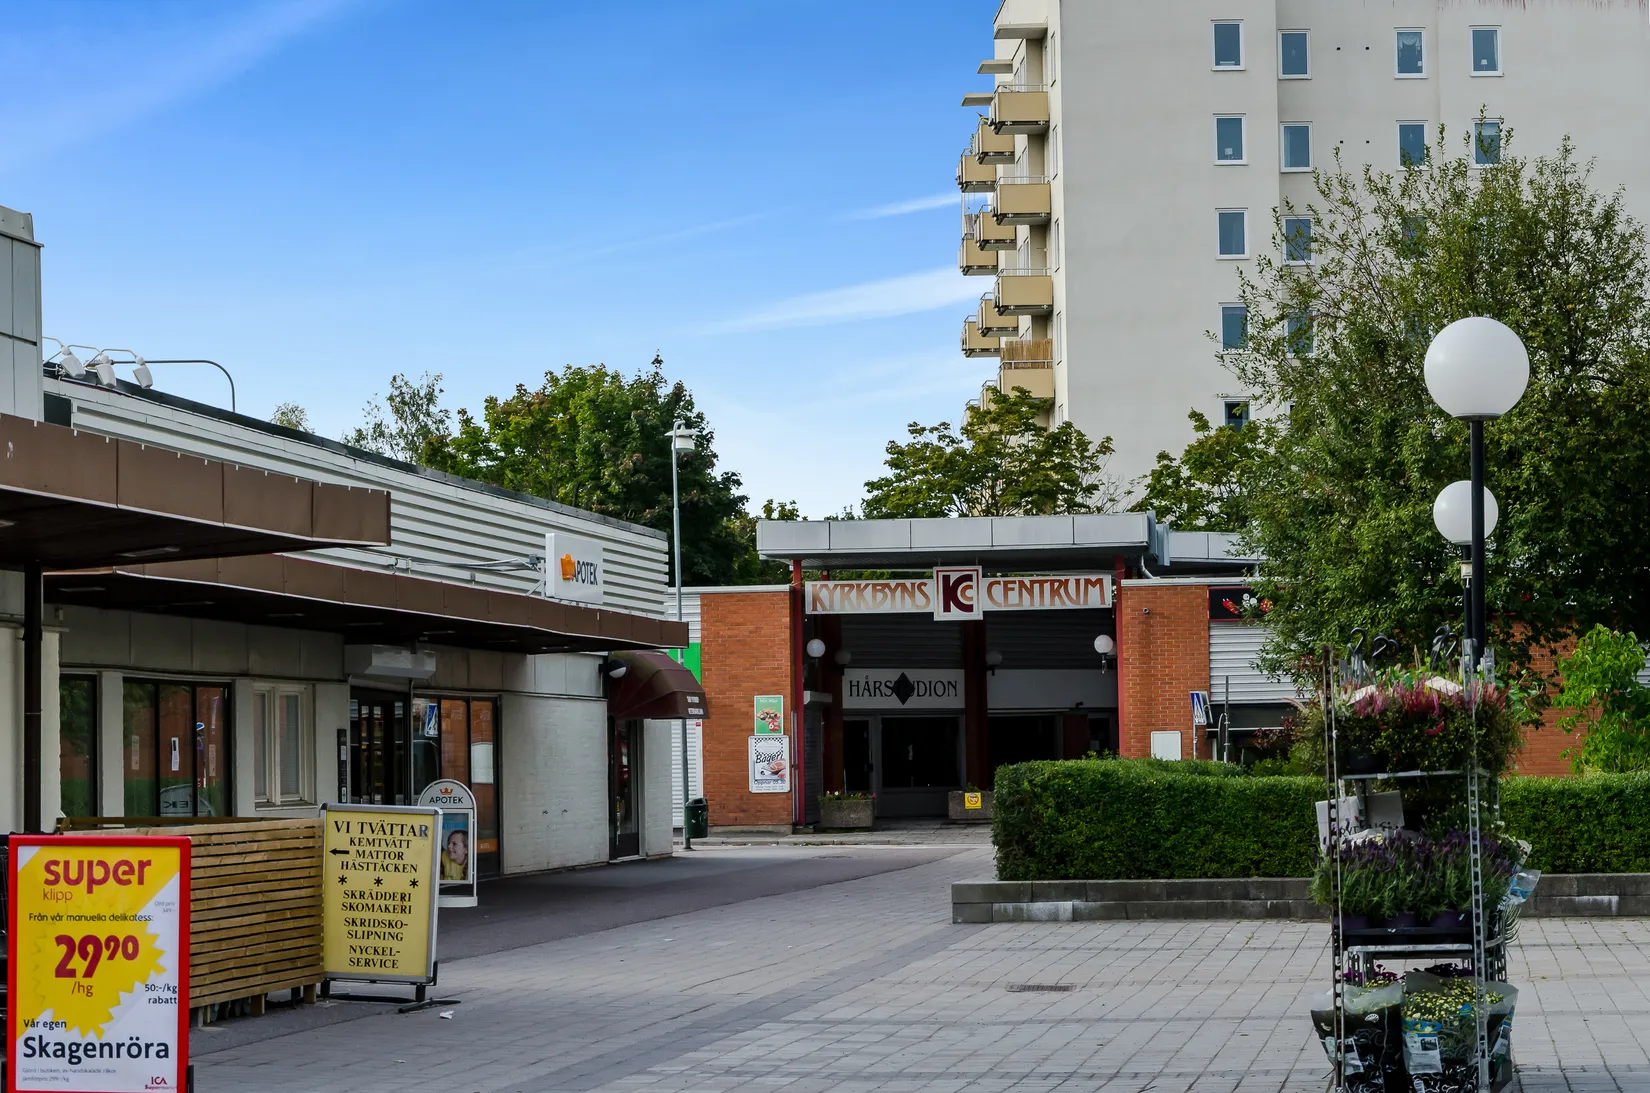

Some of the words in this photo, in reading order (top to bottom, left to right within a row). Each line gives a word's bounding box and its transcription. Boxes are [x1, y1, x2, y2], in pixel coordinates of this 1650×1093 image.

[810, 581, 931, 612] KYRKBYNS
[986, 578, 1106, 609] CENTRUM
[428, 796, 464, 804] APOTEK
[334, 820, 351, 834] VI
[357, 819, 429, 838] TVÄTTAR
[349, 836, 412, 849] KEMTVÄTT
[355, 849, 405, 861] MATTOR
[340, 860, 418, 873] HÄSTTÄCKEN
[43, 859, 152, 894] super
[43, 888, 73, 903] klipp
[343, 889, 412, 902] SKRÄDDERI
[341, 902, 412, 914] SKOMAKERI
[29, 912, 48, 922] Från
[50, 912, 63, 922] vår
[66, 912, 107, 922] manuella
[108, 912, 154, 922] delikatess:
[343, 917, 408, 929] SKRIDSKO-
[346, 930, 404, 941] SLIPNING
[349, 945, 401, 956] NYCKEL-
[348, 957, 399, 969] SERVICE
[71, 981, 94, 997] /hg
[148, 995, 177, 1005] rabatt
[23, 1018, 40, 1028] Vår
[43, 1020, 67, 1030] egen
[23, 1034, 170, 1065] Skagenröra
[151, 1076, 168, 1085] ICA
